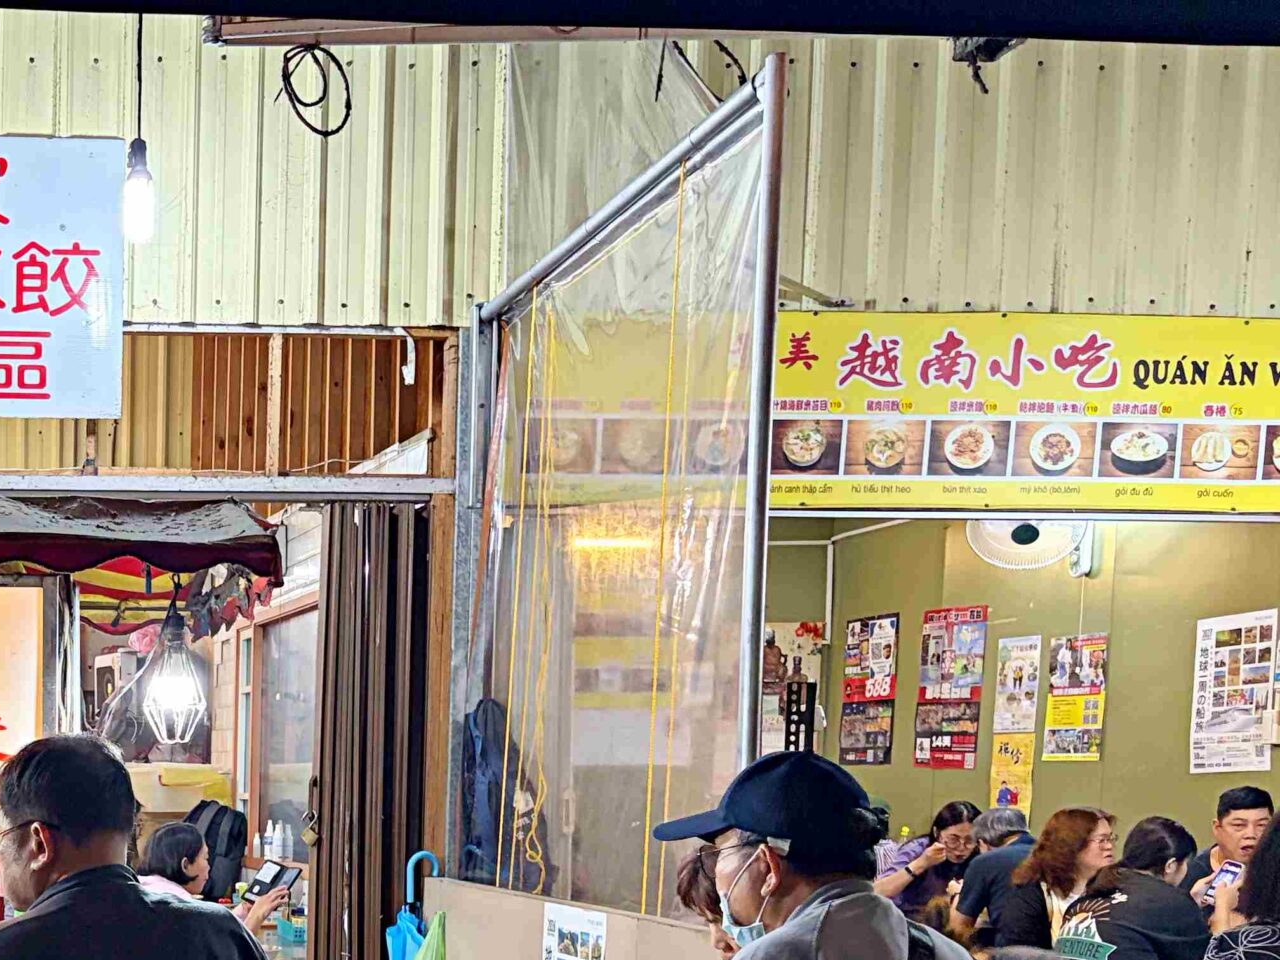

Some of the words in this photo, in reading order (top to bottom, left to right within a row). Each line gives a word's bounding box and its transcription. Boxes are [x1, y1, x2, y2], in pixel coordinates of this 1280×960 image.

[779, 331, 819, 370] 美
[838, 330, 1118, 389] 越南小吃
[1133, 355, 1209, 390] QUÁN
[1218, 354, 1258, 386] ĂN
[1233, 407, 1243, 415] 75
